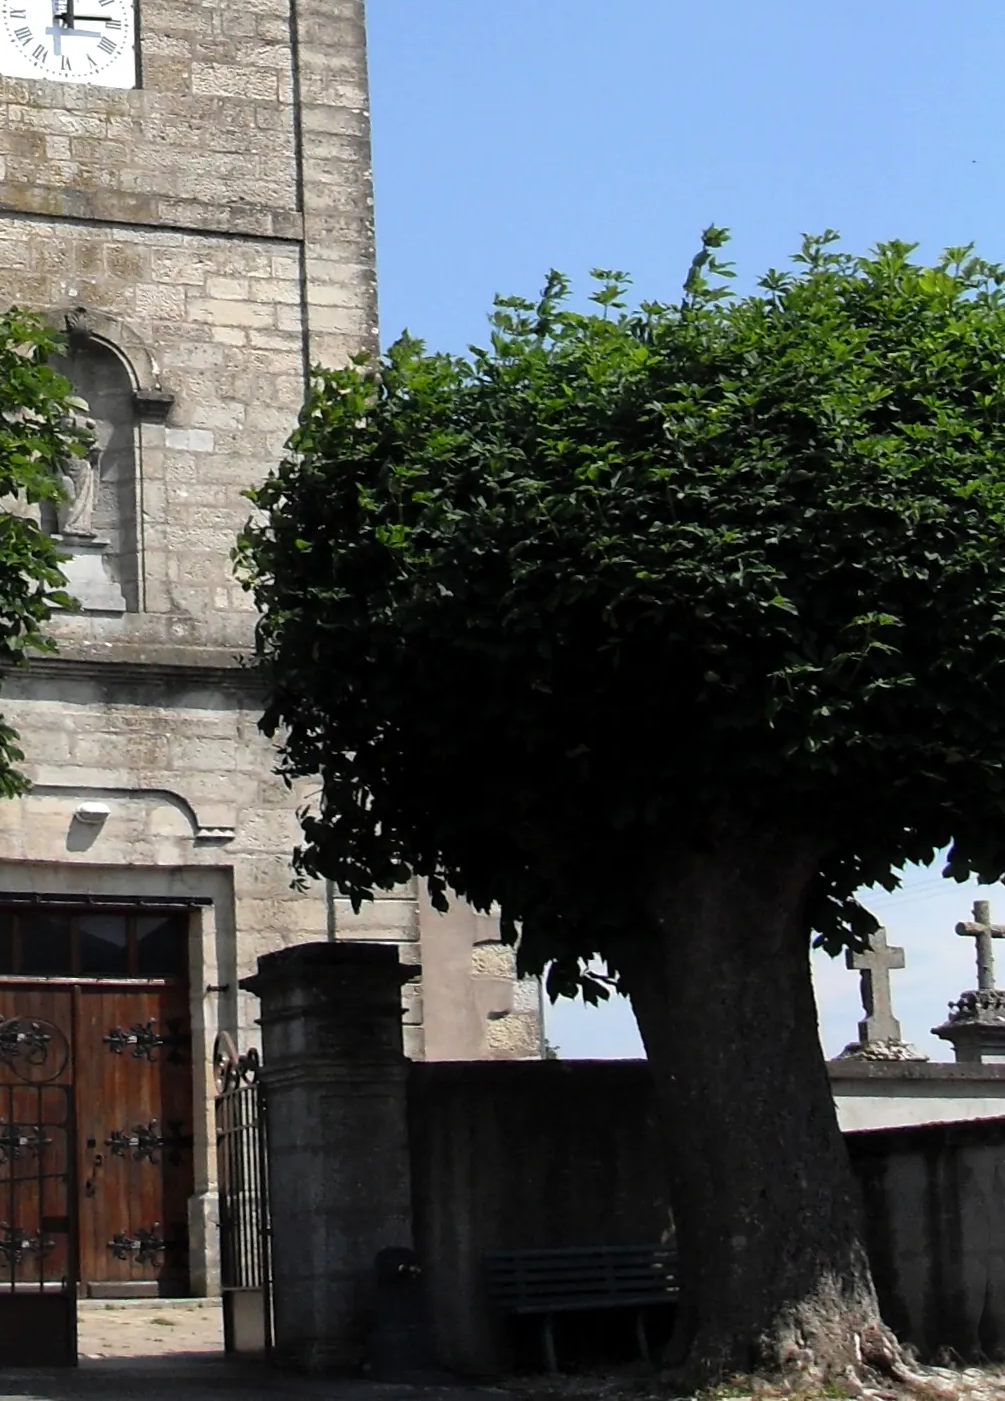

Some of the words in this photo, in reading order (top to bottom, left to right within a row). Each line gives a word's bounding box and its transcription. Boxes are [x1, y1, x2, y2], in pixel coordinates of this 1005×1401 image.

[105, 20, 121, 30] III
[97, 36, 117, 55] IIII
[61, 55, 72, 70] VI
